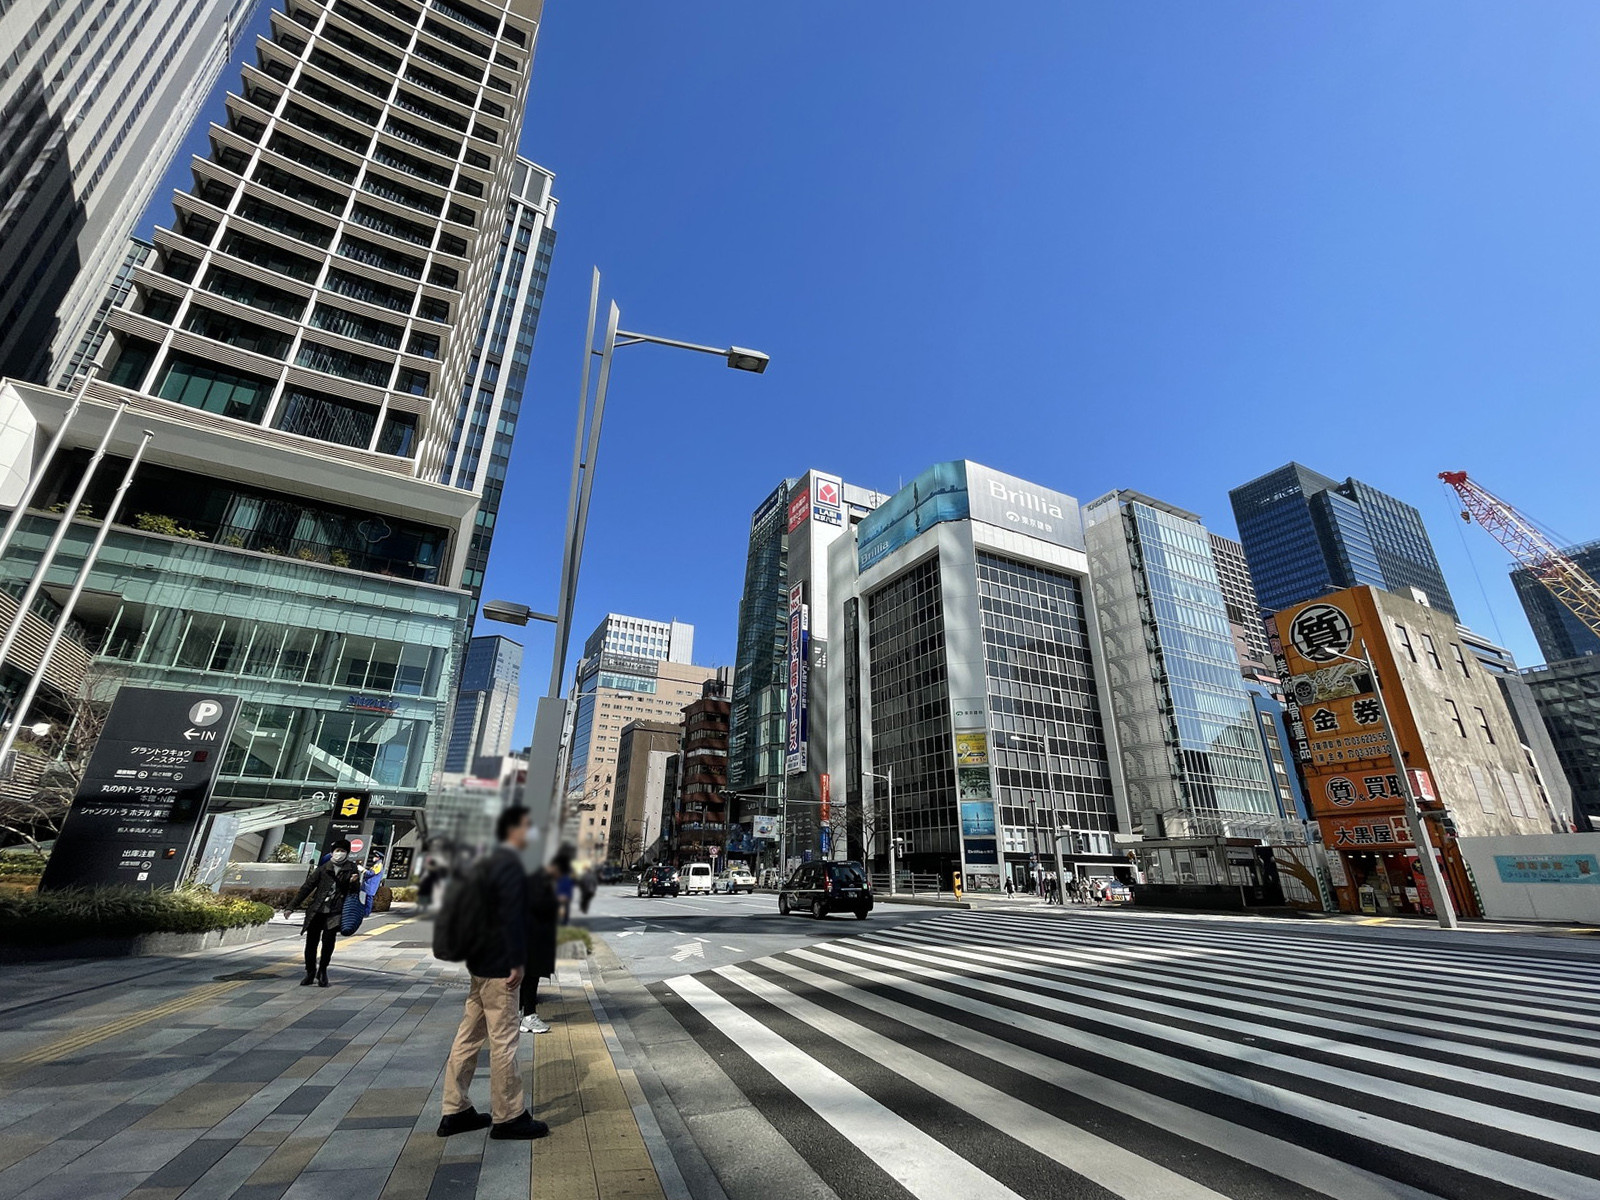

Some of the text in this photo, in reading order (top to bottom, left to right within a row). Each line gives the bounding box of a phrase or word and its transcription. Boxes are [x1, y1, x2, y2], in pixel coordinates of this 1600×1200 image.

[987, 479, 1064, 520] Brillia
[861, 541, 889, 565] Brillia
[194, 702, 218, 723] P
[200, 730, 217, 741] IN
[131, 747, 192, 757] グラントウキョウ
[146, 756, 189, 764] ノースタワー
[101, 784, 178, 795] 丸の内トラストタワー
[129, 809, 152, 818] ホテル
[1335, 825, 1394, 845] 大黒屋
